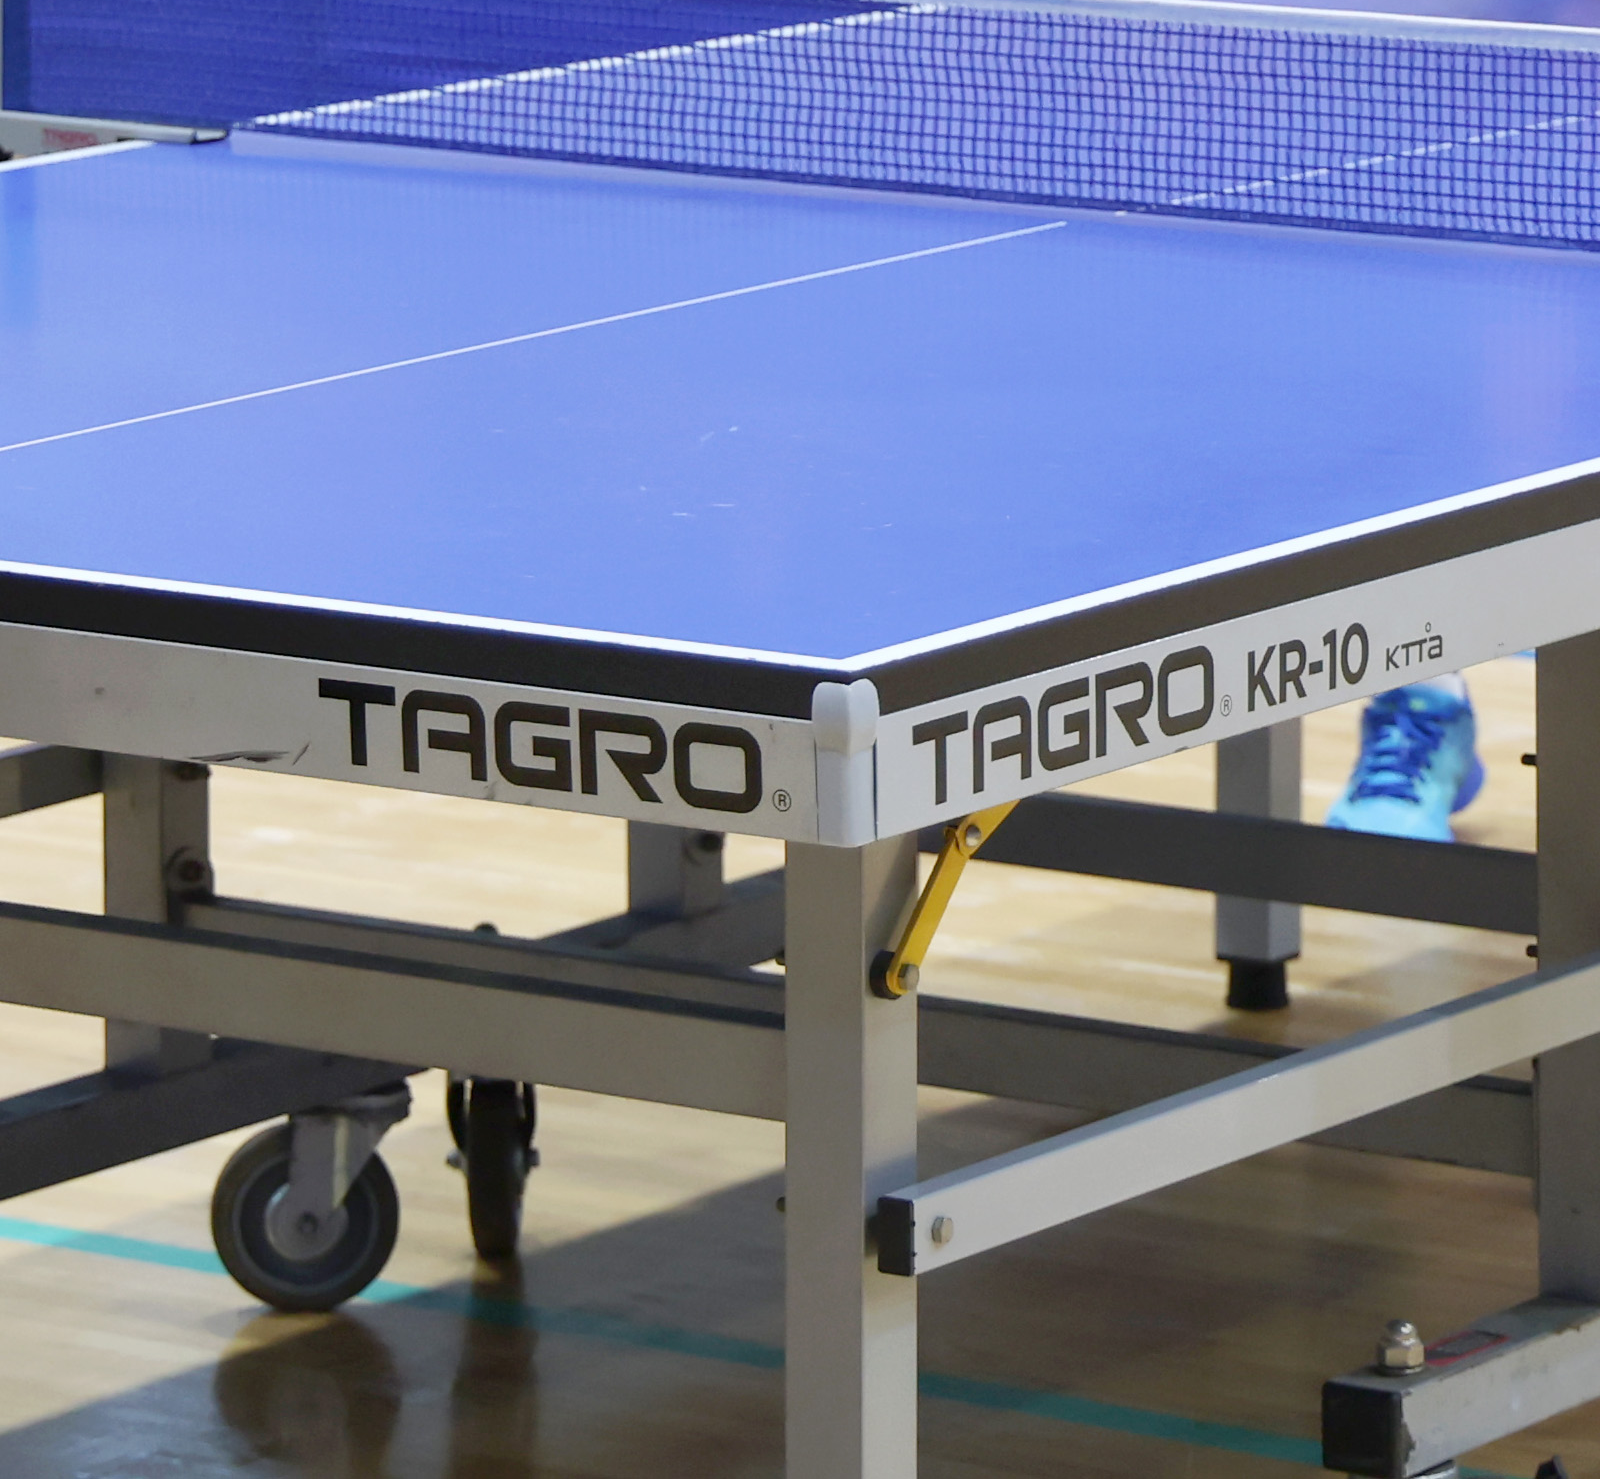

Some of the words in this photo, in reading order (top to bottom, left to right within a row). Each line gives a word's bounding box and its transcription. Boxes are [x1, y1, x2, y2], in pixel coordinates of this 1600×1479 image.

[318, 677, 763, 814] TAGRO
[912, 645, 1215, 806] TAGRO
[1247, 622, 1369, 713] KR-10
